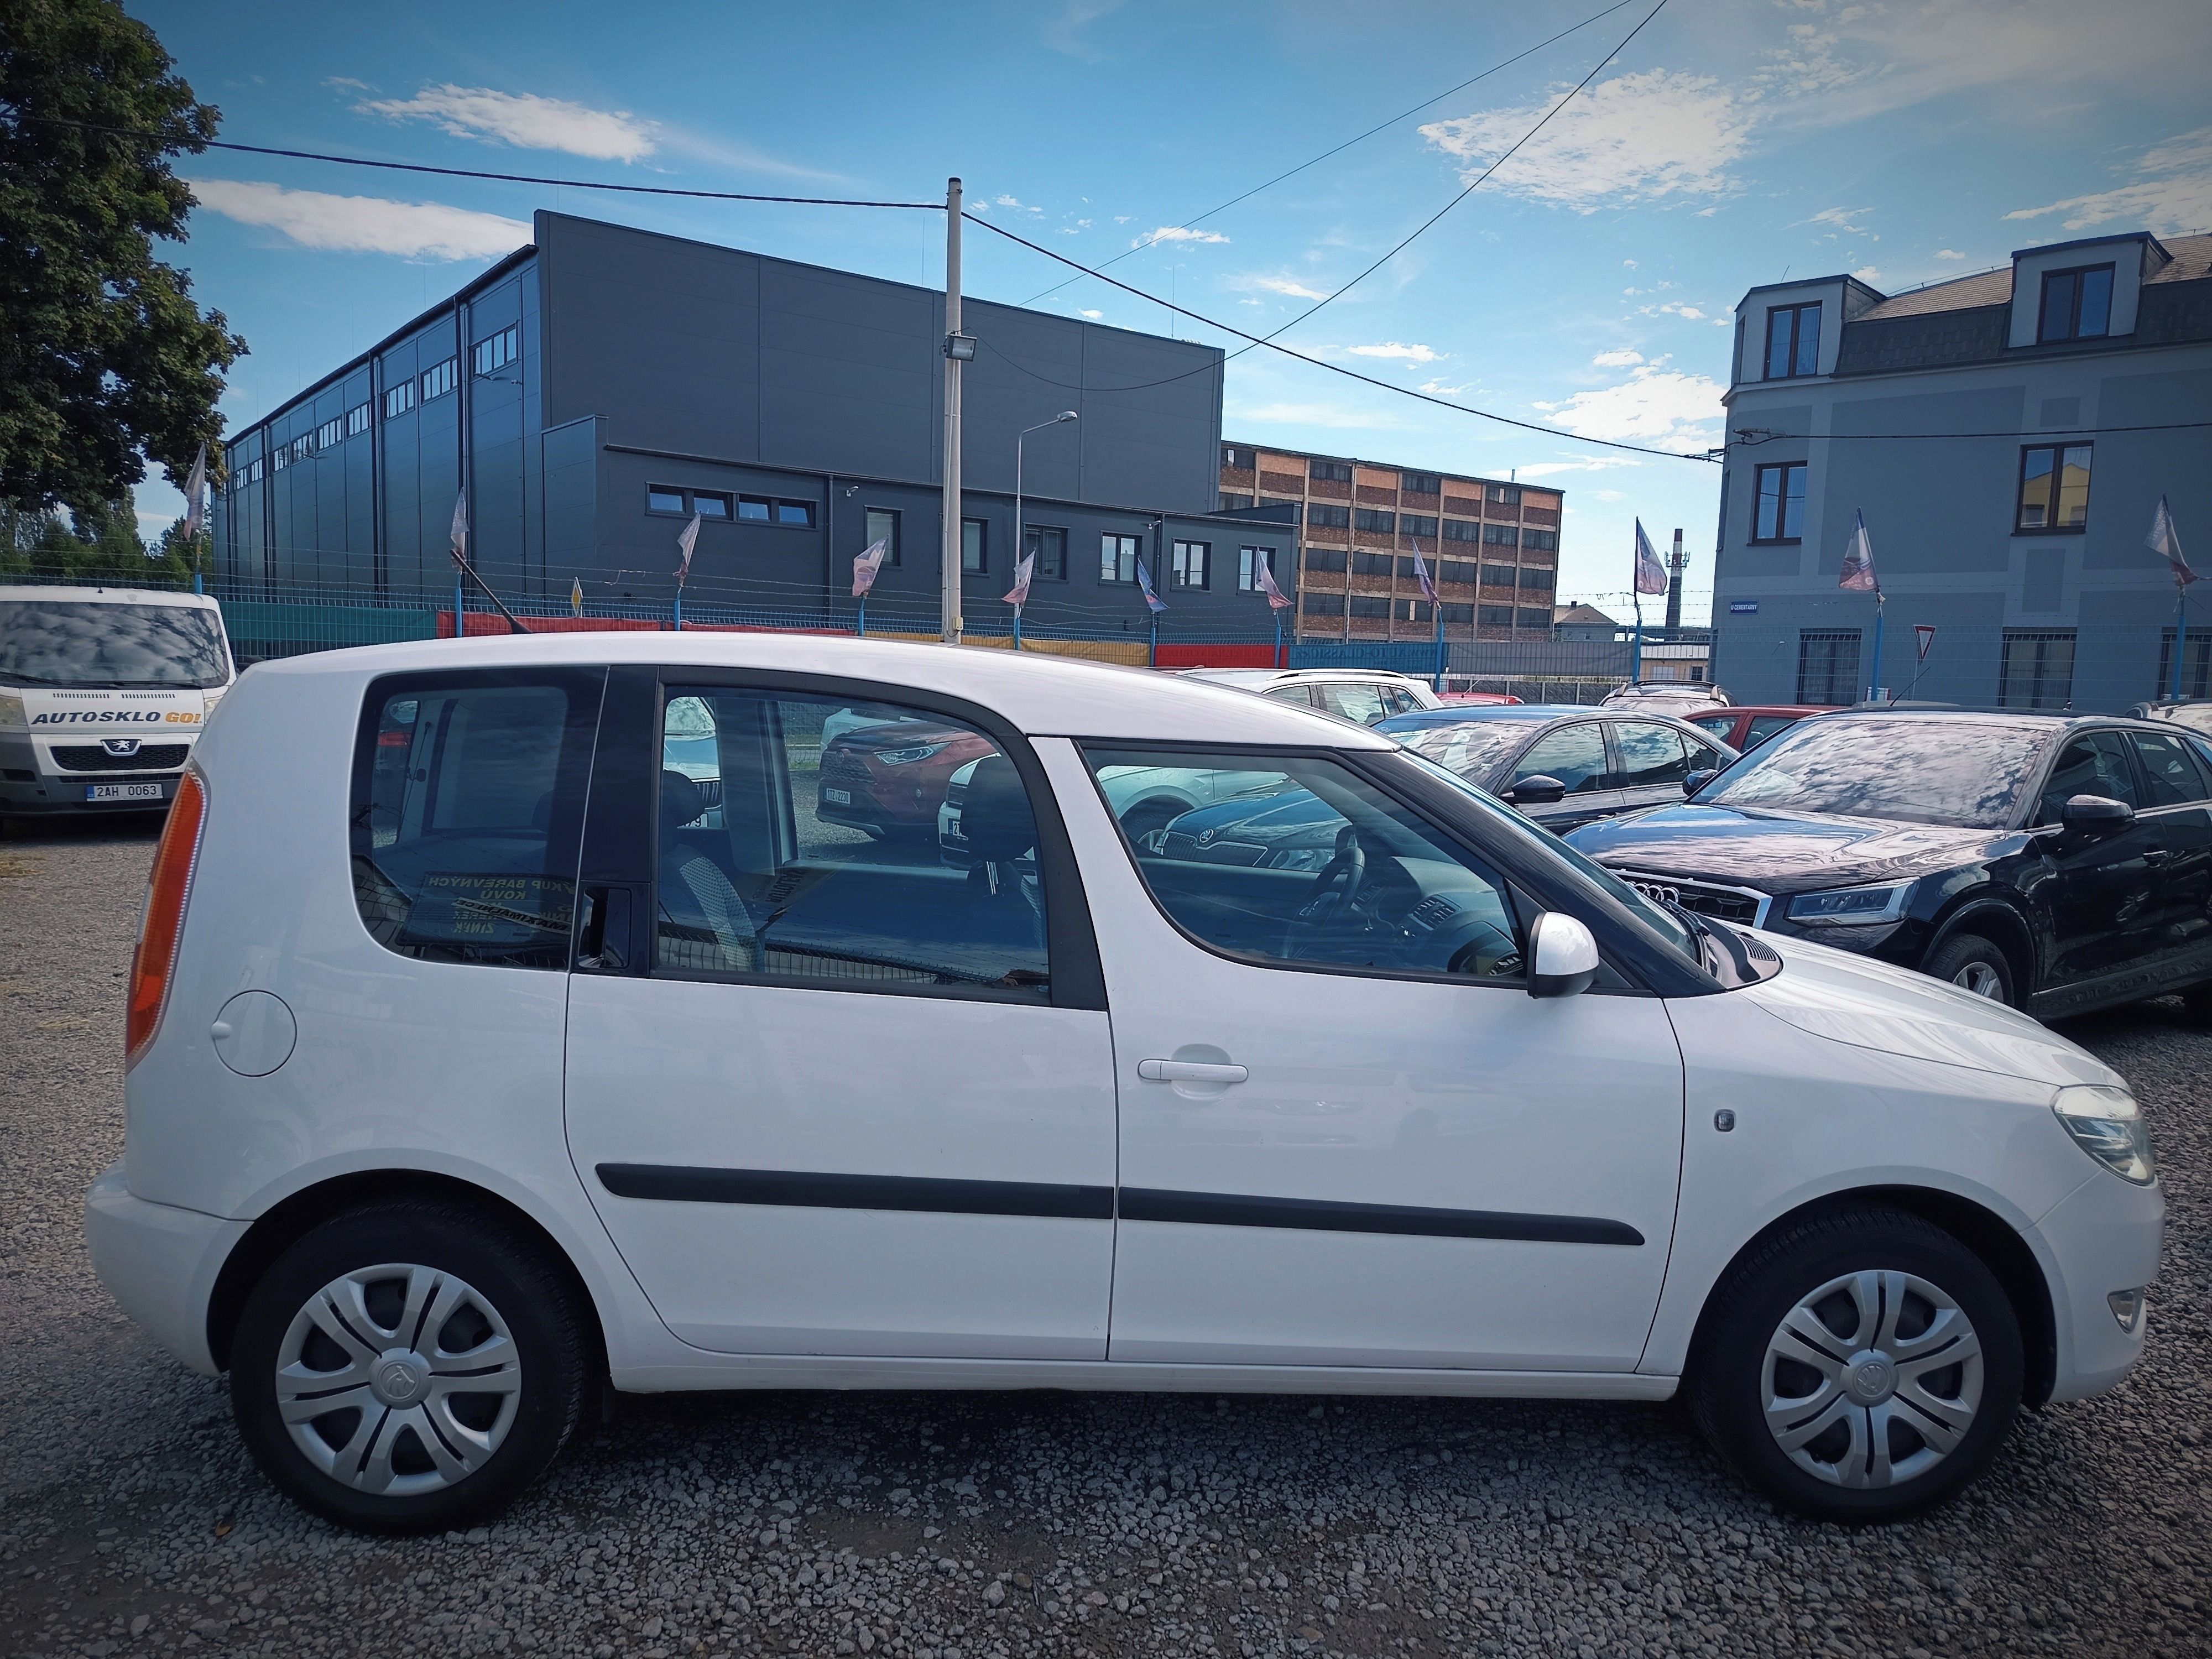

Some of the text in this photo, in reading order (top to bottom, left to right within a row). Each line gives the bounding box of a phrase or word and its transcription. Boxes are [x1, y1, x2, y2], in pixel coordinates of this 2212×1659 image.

[31, 712, 201, 725] AUTOSKLO GO!
[97, 786, 118, 797] 2AH
[128, 786, 156, 796] 0063
